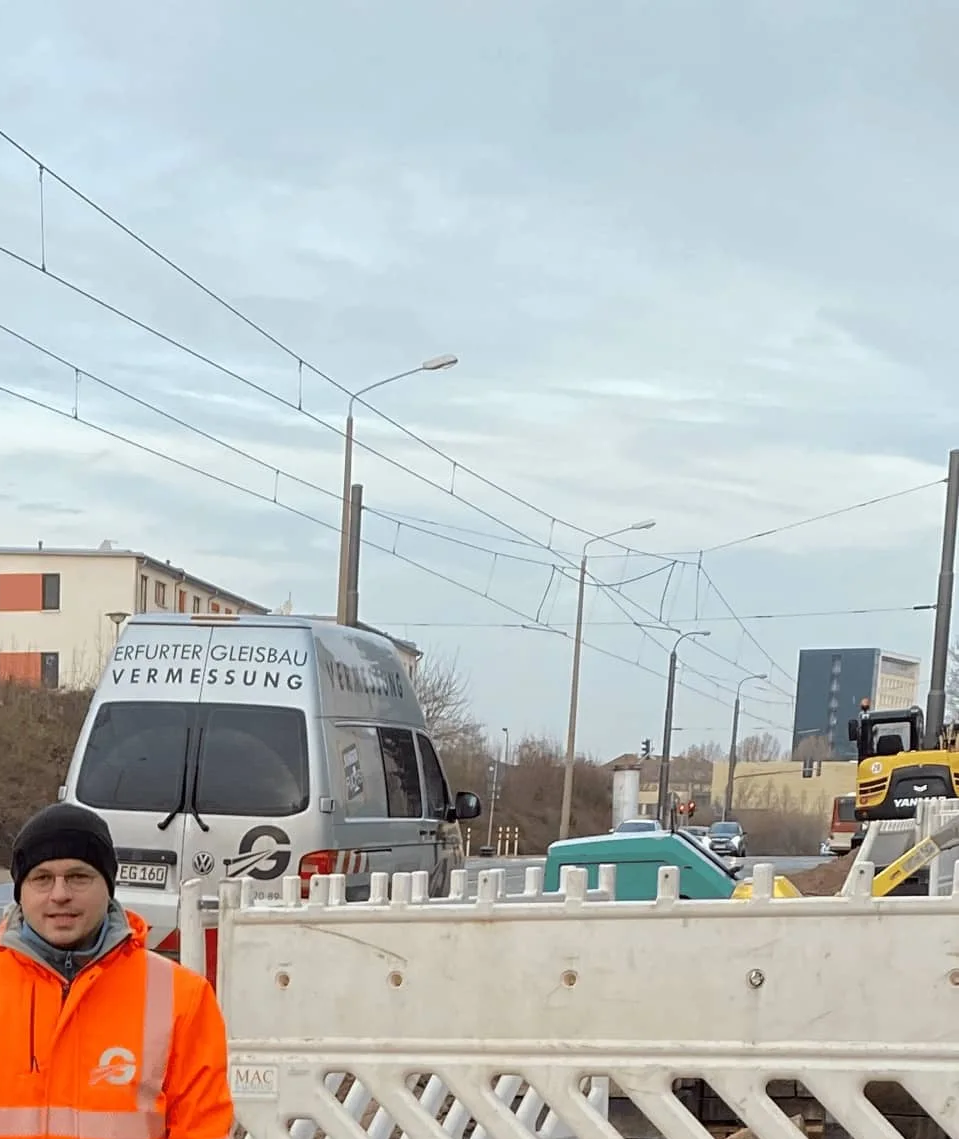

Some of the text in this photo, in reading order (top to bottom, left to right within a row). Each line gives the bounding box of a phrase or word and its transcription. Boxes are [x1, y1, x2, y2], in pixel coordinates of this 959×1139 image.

[113, 643, 308, 667] ERFURTER GLEISBAU
[112, 667, 304, 690] VERMESSUNG
[119, 865, 165, 882] EG 160
[235, 1069, 274, 1085] MAC
